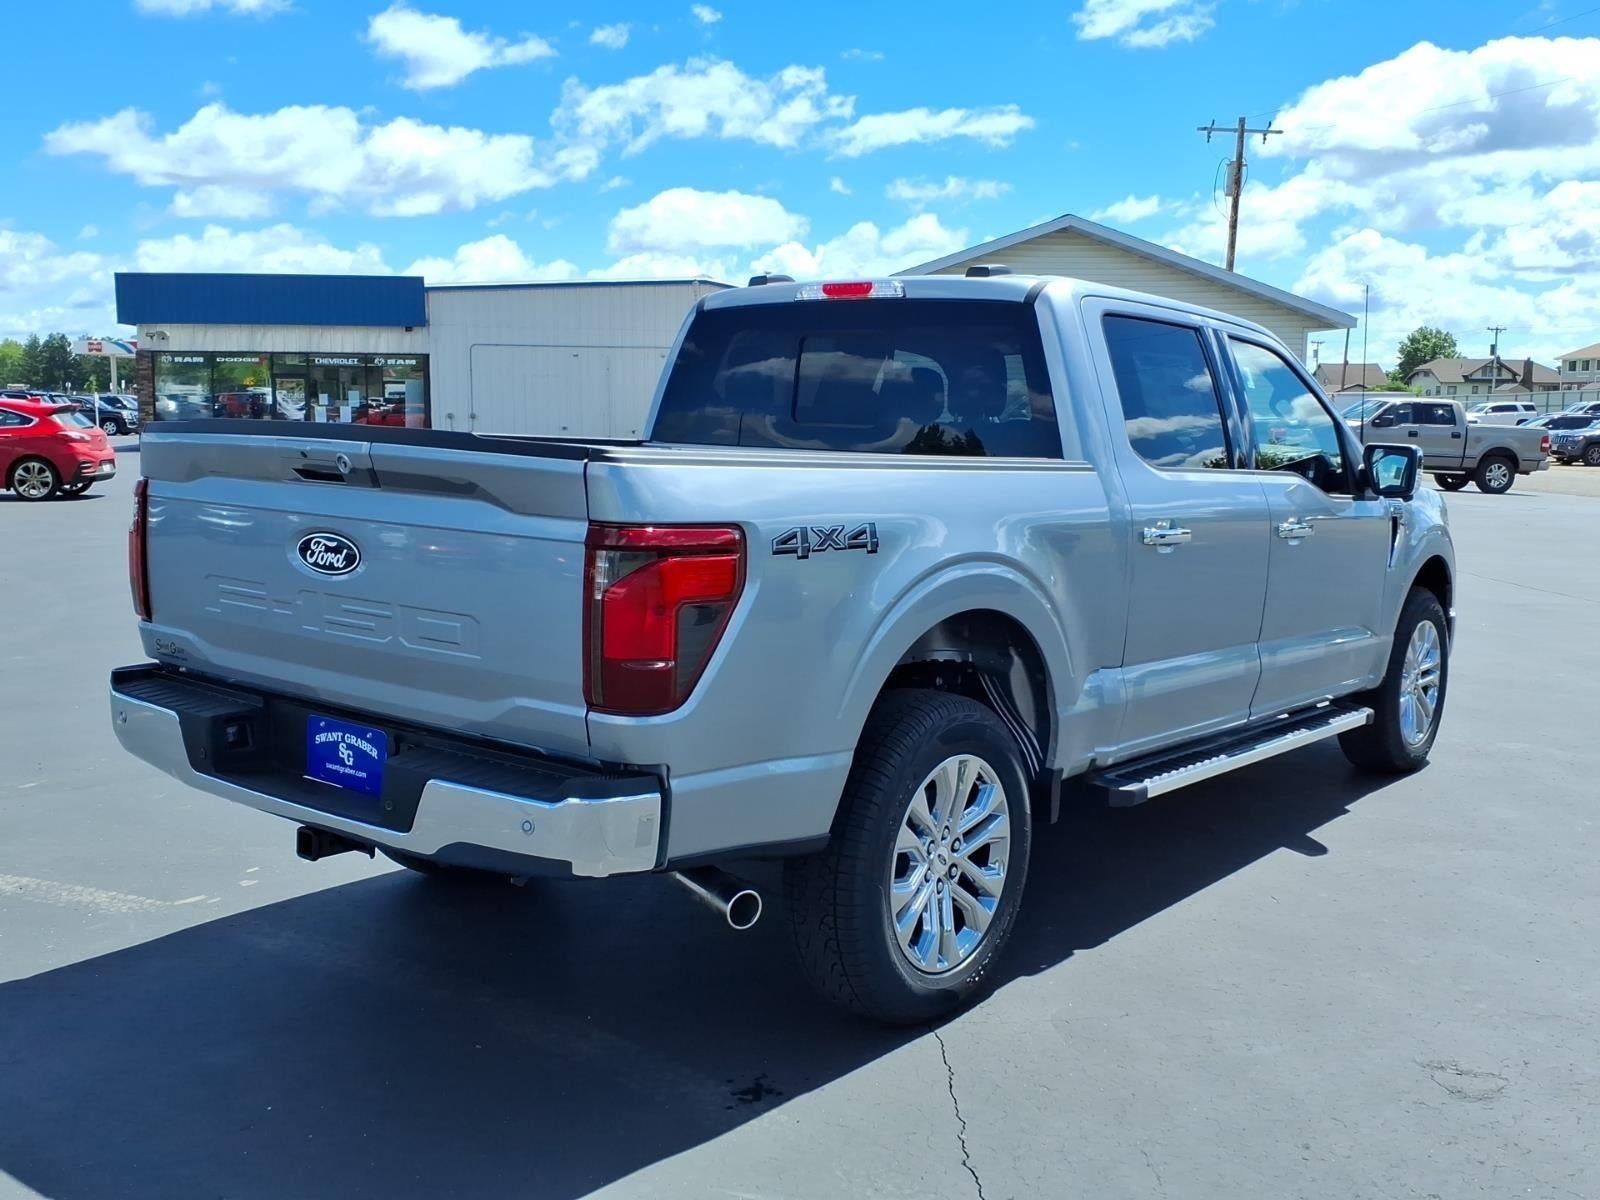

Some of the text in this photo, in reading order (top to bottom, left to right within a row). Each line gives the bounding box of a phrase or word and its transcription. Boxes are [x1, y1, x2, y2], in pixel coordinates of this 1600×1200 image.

[306, 538, 348, 568] Ford
[203, 573, 482, 660] F-150
[315, 732, 378, 760] SWANT GRABER
[338, 742, 354, 766] SG
[325, 762, 367, 779] swantgraber.com
